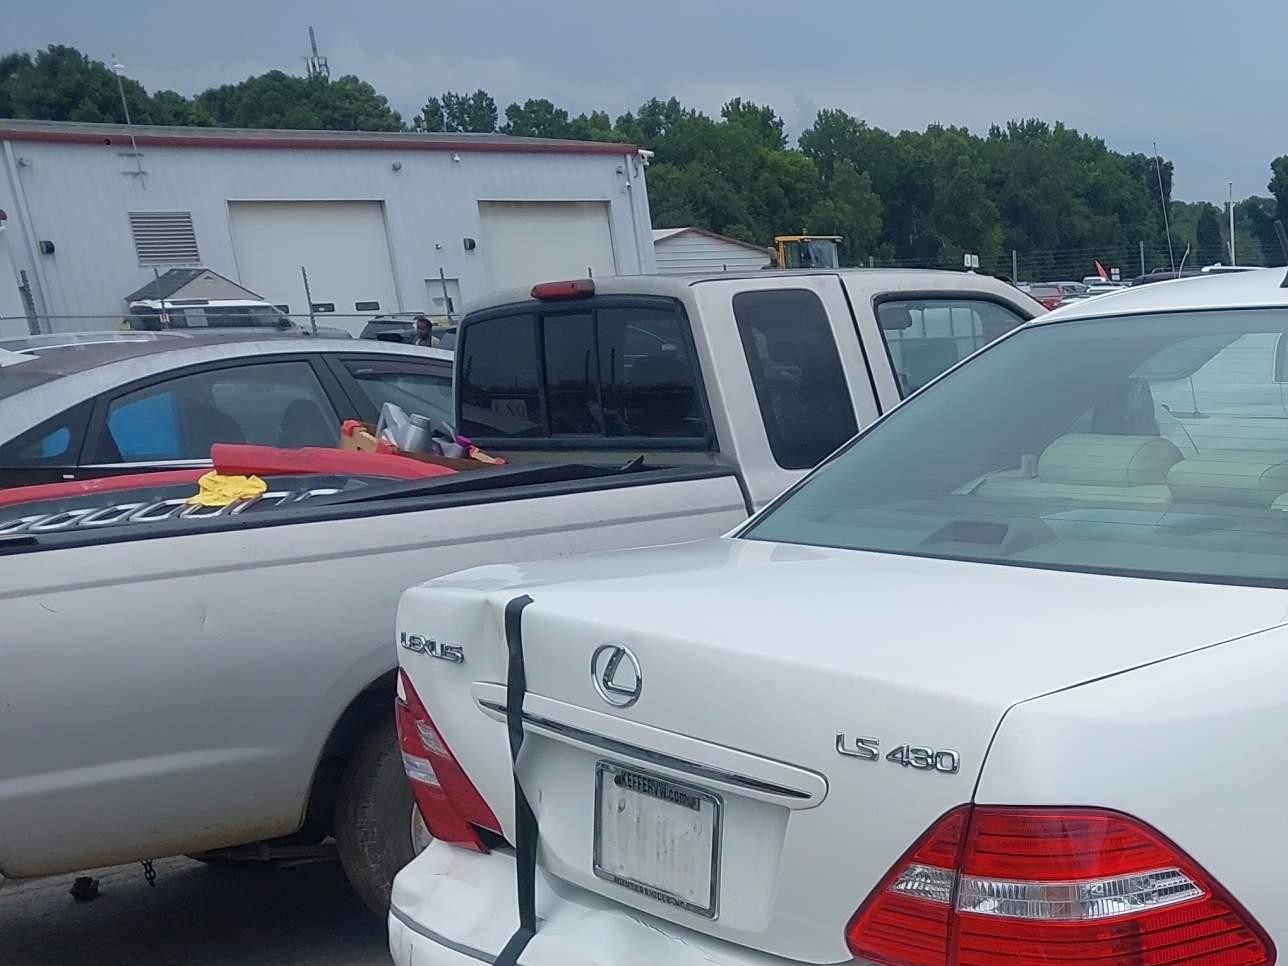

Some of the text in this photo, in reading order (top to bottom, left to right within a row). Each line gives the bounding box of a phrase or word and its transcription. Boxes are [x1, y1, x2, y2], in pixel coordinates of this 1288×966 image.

[400, 631, 465, 664] LEXUS
[835, 732, 960, 774] LS 430
